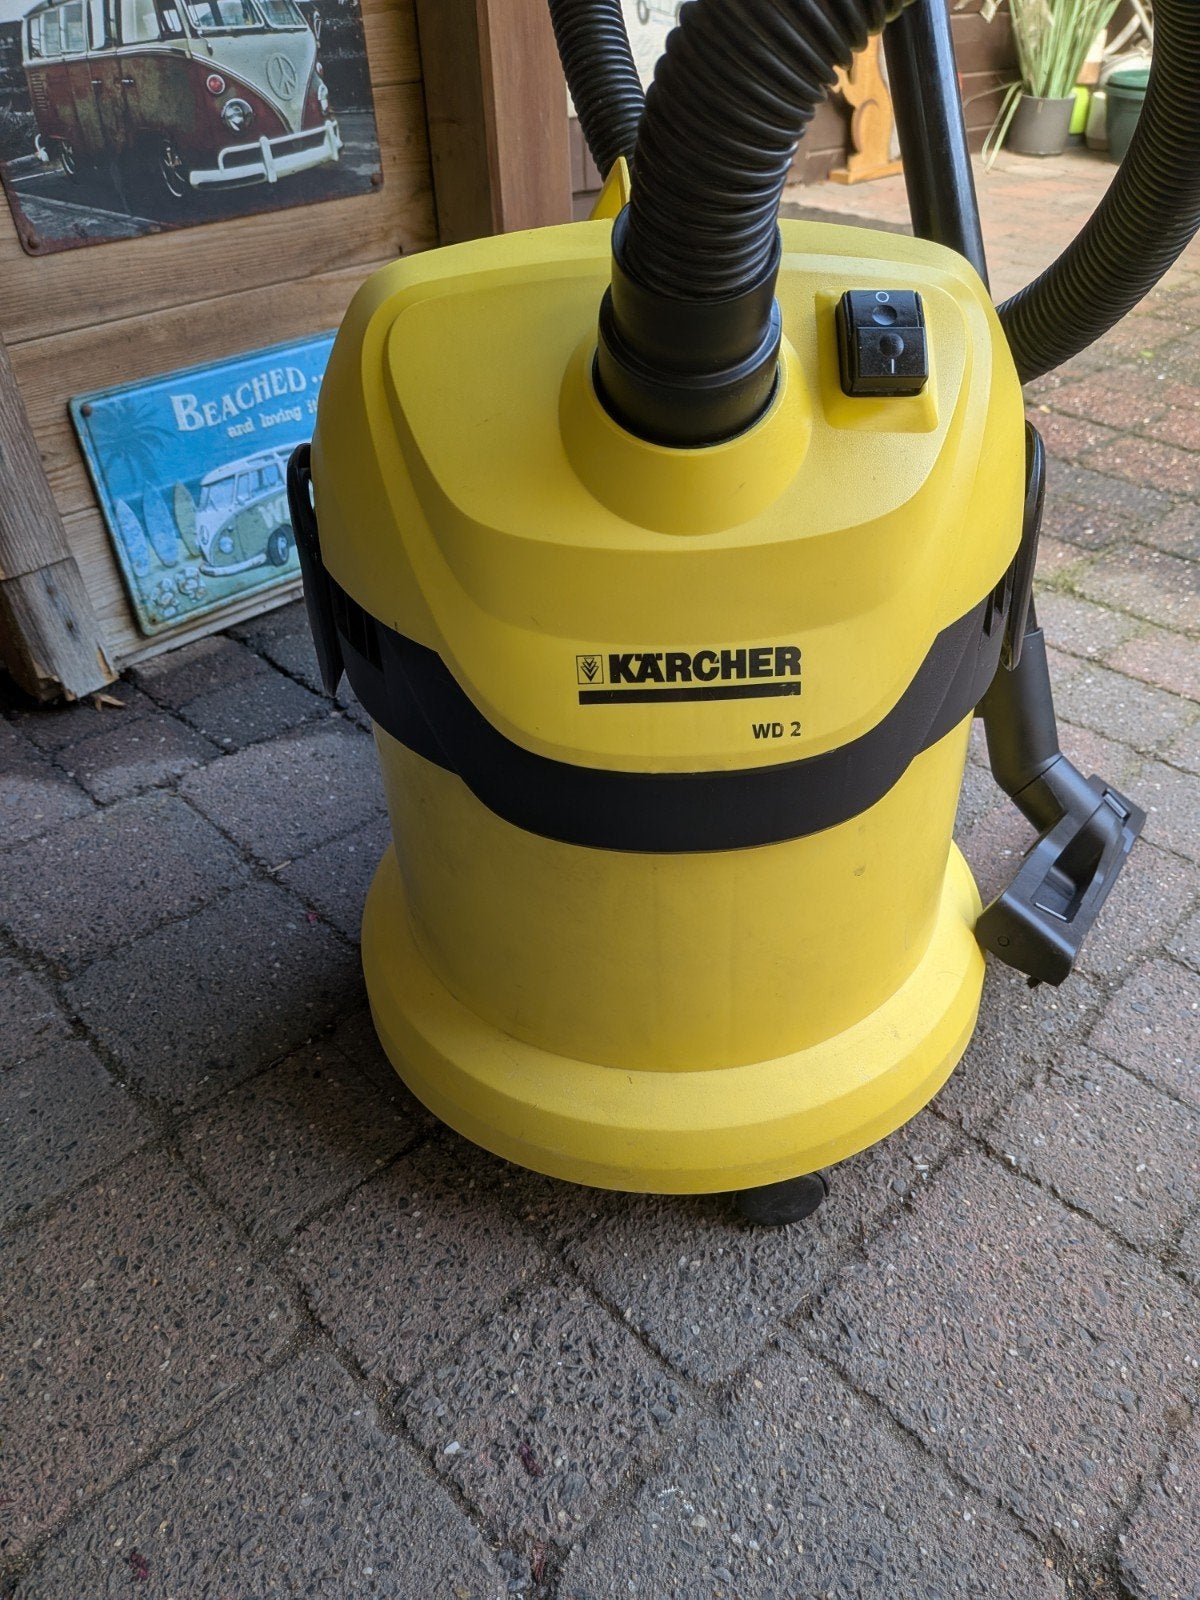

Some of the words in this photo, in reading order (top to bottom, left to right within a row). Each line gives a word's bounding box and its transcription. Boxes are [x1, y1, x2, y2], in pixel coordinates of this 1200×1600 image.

[227, 416, 255, 439] and
[258, 405, 303, 429] loving
[608, 645, 802, 684] KÄRCHER
[752, 721, 784, 740] WD
[790, 721, 802, 738] 2
